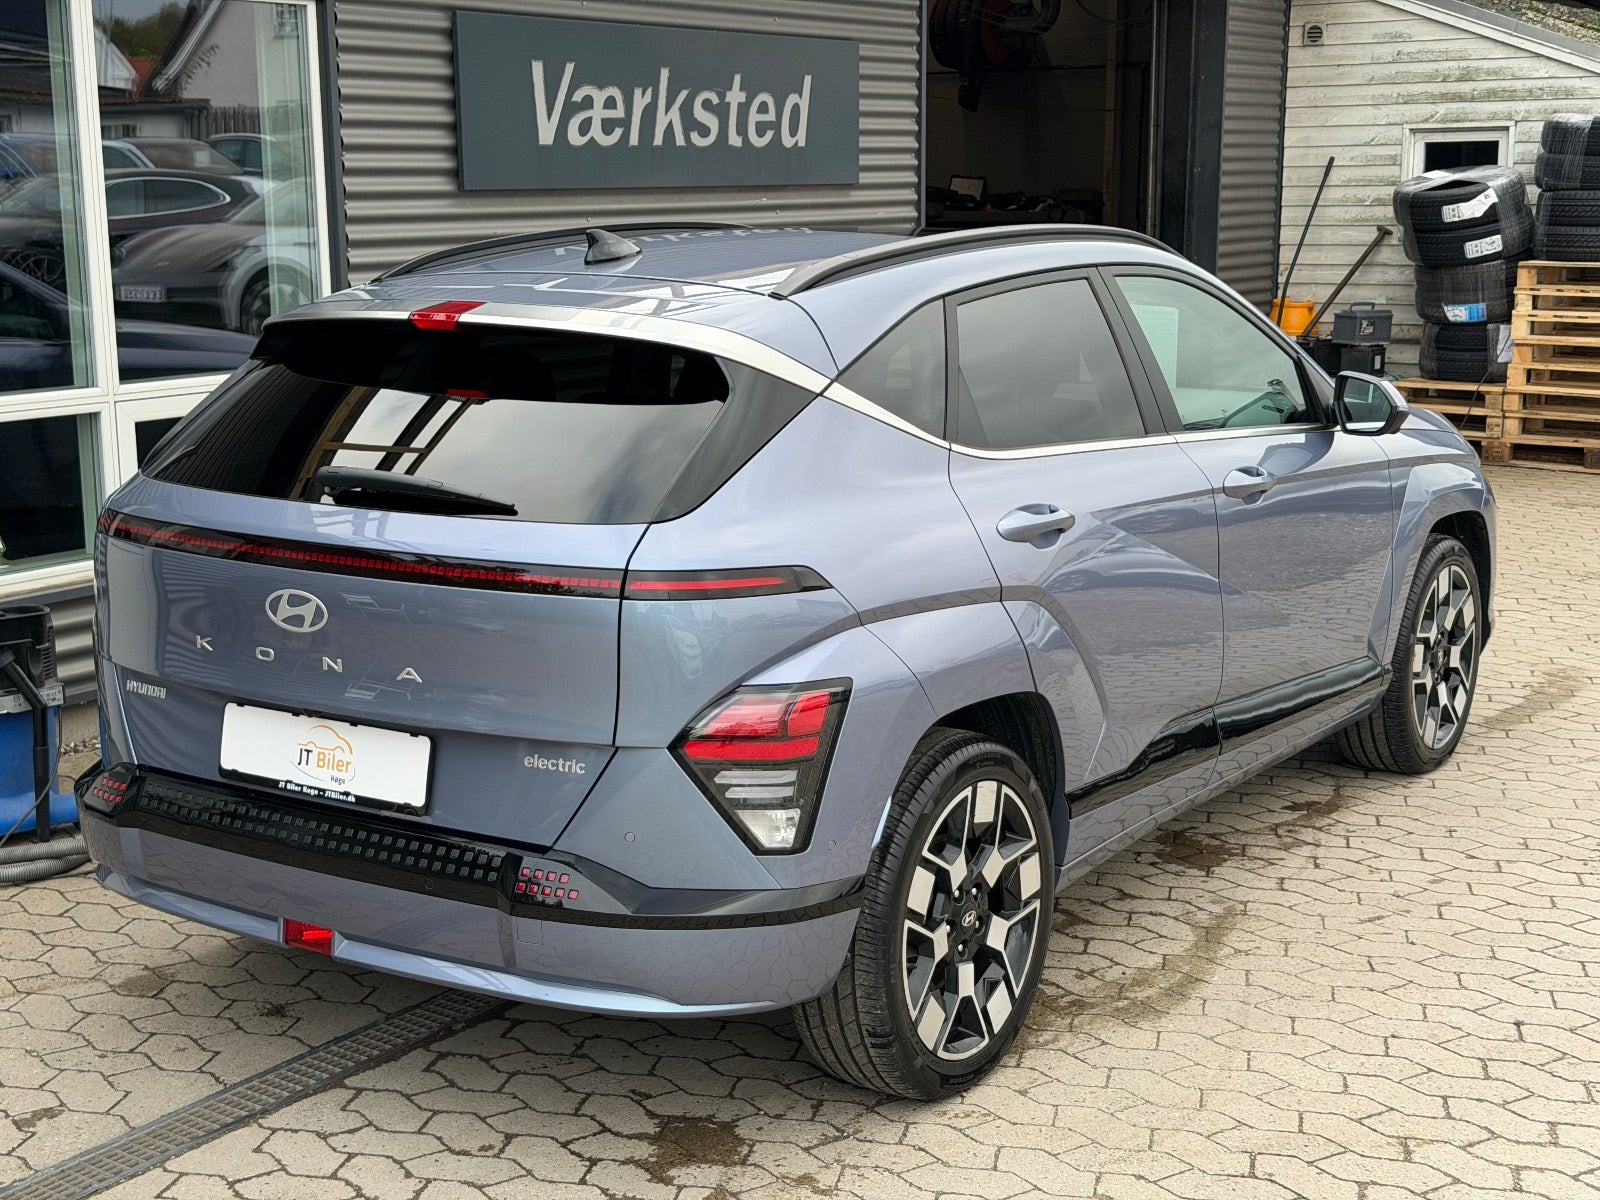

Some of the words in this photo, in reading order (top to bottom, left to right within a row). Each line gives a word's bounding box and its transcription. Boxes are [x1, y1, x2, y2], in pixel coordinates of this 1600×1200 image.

[532, 59, 811, 148] Værksted
[196, 635, 423, 683] KONA
[126, 679, 167, 699] HYUNDAI
[298, 748, 313, 765] JT
[317, 752, 351, 773] Biler
[524, 754, 586, 774] electric
[286, 783, 301, 792] Biler
[330, 775, 346, 785] Køge
